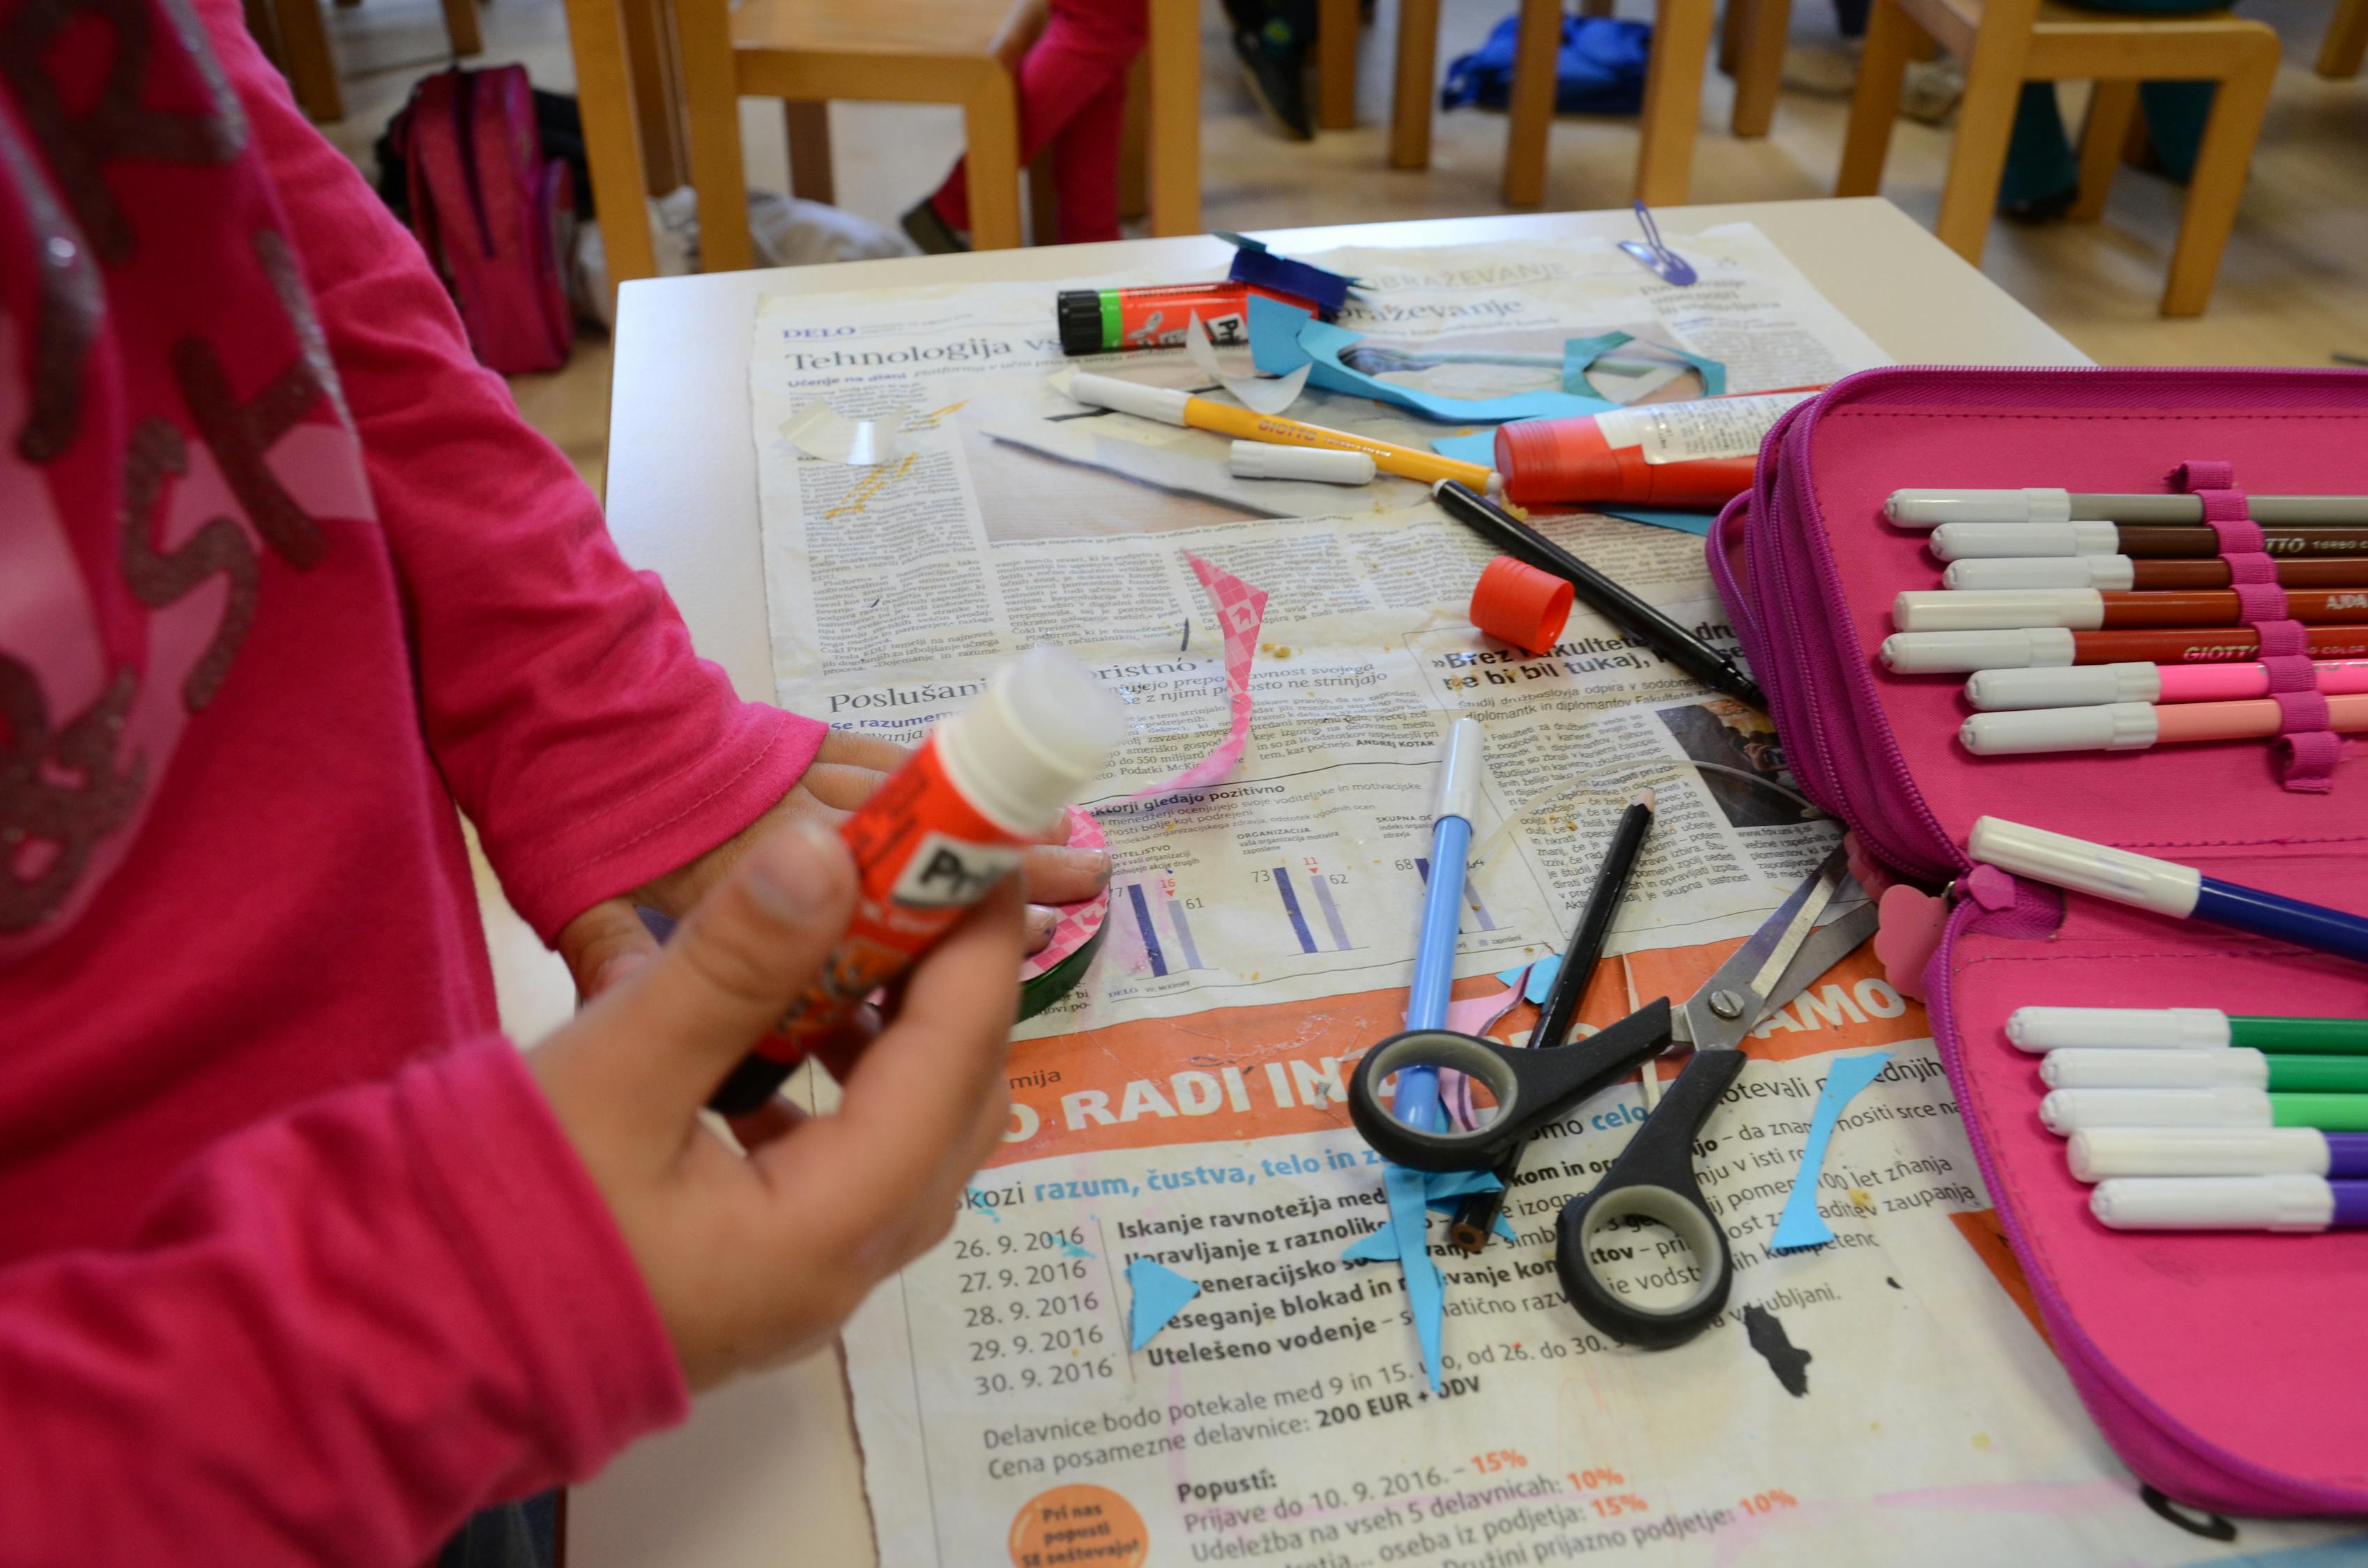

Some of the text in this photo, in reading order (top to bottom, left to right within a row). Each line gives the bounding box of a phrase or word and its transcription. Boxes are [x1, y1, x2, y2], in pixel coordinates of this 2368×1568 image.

[782, 327, 856, 338] DELO
[785, 338, 1012, 371] Tehnologija
[1258, 419, 1317, 442] GIOTTO
[2265, 538, 2305, 553] TTO
[2183, 643, 2258, 661] GIOTT
[1311, 663, 1375, 680] svojega
[1487, 670, 1515, 686] bi
[1521, 663, 1559, 680] bil
[1564, 652, 1649, 675] tukaj,
[1161, 686, 1210, 704] njimi
[1288, 679, 1309, 688] ne
[1313, 671, 1388, 687] strinjajo
[1585, 683, 1623, 694] odpira
[1180, 705, 1225, 717] strinjalo
[1541, 698, 1632, 716] in diplomantov
[1126, 744, 1177, 755] ameriško
[1260, 739, 1435, 760] tem, kar ANDREJ KOTAR
[1270, 740, 1283, 748] so
[1161, 751, 1205, 763] milijard
[1120, 766, 1163, 776] Podatki
[1108, 809, 1175, 826] menedžerji
[1177, 802, 1239, 815] ocenjujejo
[1242, 797, 1271, 808] svoje
[1274, 787, 1336, 805] voditeljske
[1353, 783, 1421, 792] motivacijske
[1144, 793, 1204, 811] gledajo
[1209, 783, 1285, 802] pozitivno
[1141, 810, 1253, 832] bolje kot podrejeni
[1237, 827, 1311, 840] ORGANIZACIJA
[1111, 845, 1170, 859] DITELJSTVO
[1302, 857, 1319, 866] 11
[1394, 859, 1414, 871] 68
[1161, 878, 1175, 889] 16
[1251, 870, 1271, 884] 73
[1329, 874, 1349, 885] 62
[1663, 881, 1703, 897] skupna
[1185, 898, 1205, 910] 61
[1108, 980, 1190, 998] DELO McKinsey
[1060, 1066, 1252, 1132] RADI
[1739, 1125, 1765, 1141] da
[1896, 1104, 1937, 1119] srce
[1752, 1150, 1785, 1169] isti
[1034, 1171, 1140, 1204] razum,
[1146, 1165, 1255, 1194] čustva,
[1260, 1154, 1320, 1181] telo
[1326, 1147, 1357, 1170] in
[1851, 1170, 1885, 1190] let
[1885, 1157, 1954, 1182] znanja
[1117, 1214, 1204, 1241] Iskanje
[1209, 1195, 1332, 1229] ravnotežja
[1337, 1188, 1388, 1208] med
[1561, 1162, 1584, 1177] in
[1883, 1183, 1977, 1213] zaupanja
[954, 1227, 1085, 1260] 26. 9. 2016
[1267, 1240, 1280, 1254] z
[958, 1260, 1087, 1294] 27. 9. 2016
[963, 1291, 1099, 1328] 28. 9. 2016
[1160, 1279, 1393, 1335] eseganje blokad in
[969, 1325, 1104, 1362] 29. 9. 2016
[1147, 1317, 1377, 1369] Utelešeno vodenje
[975, 1358, 1114, 1397] 30. 9. 2016
[982, 1335, 1607, 1450] Delavnice bodo potekale med 9 in 15. od 26. do 30.
[988, 1458, 1046, 1481] Cena
[1053, 1434, 1186, 1475] posamezne
[1193, 1417, 1313, 1447] delavnice:
[1315, 1402, 1362, 1430] 200
[1366, 1393, 1413, 1418] EUR
[1177, 1470, 1278, 1503] Popusti:
[1183, 1448, 1529, 1535] Prijave do 10. 9. 2016. 15%
[1041, 1504, 1103, 1523] Pri nas
[1191, 1530, 1305, 1563] Udeležba
[1309, 1525, 1339, 1545] na
[1345, 1509, 1404, 1536] vseh
[1408, 1503, 1424, 1523] 5
[1430, 1476, 1562, 1516] delavnicah:
[1566, 1468, 1625, 1494] 10%
[1042, 1522, 1110, 1546] popusti
[1379, 1534, 1452, 1562] oseba
[1454, 1523, 1478, 1545] iz
[1485, 1504, 1587, 1547] podjetja:
[1590, 1494, 1649, 1520] 15%
[1535, 1530, 1628, 1565] prijazno
[1631, 1507, 1736, 1551] podjetje:
[1739, 1489, 1798, 1516] 10%
